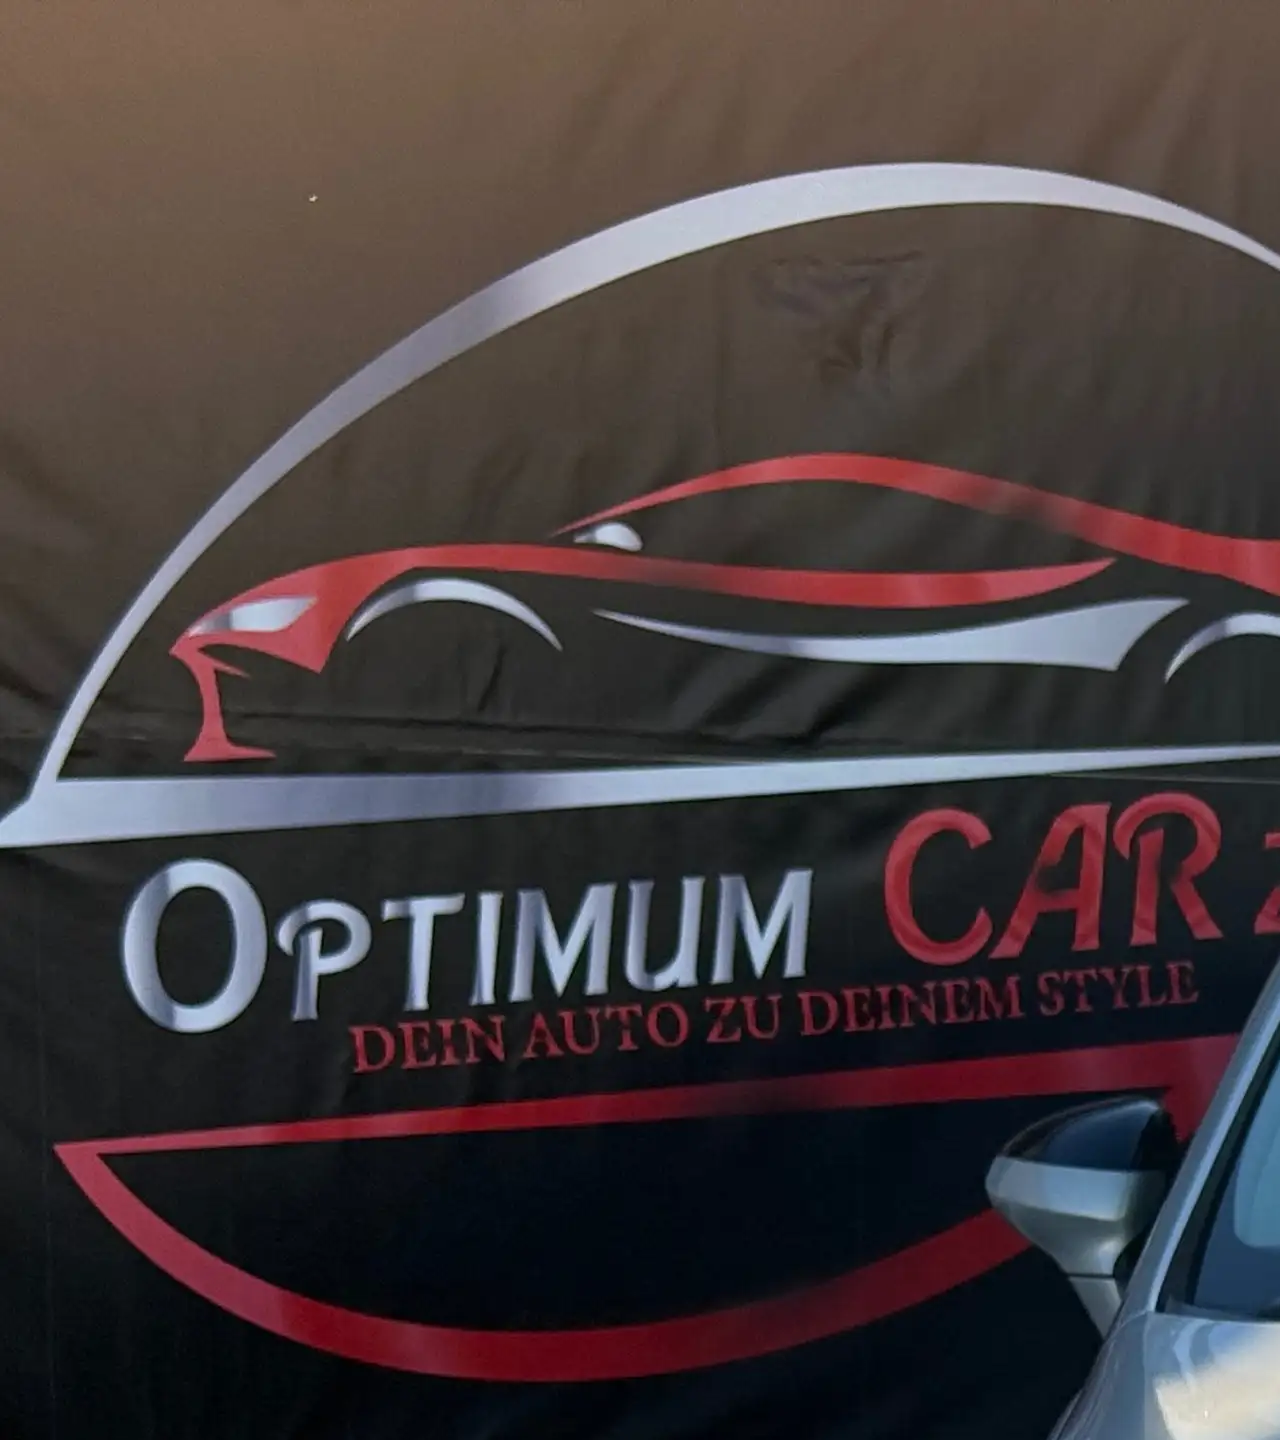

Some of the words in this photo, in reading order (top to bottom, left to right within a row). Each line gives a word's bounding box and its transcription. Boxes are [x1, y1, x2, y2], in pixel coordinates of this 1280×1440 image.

[348, 1013, 505, 1074] DEIN
[524, 1001, 689, 1059] AUTO
[705, 993, 782, 1044] ZU
[797, 974, 1025, 1038] DEINEM
[1040, 960, 1200, 1018] STYLE
